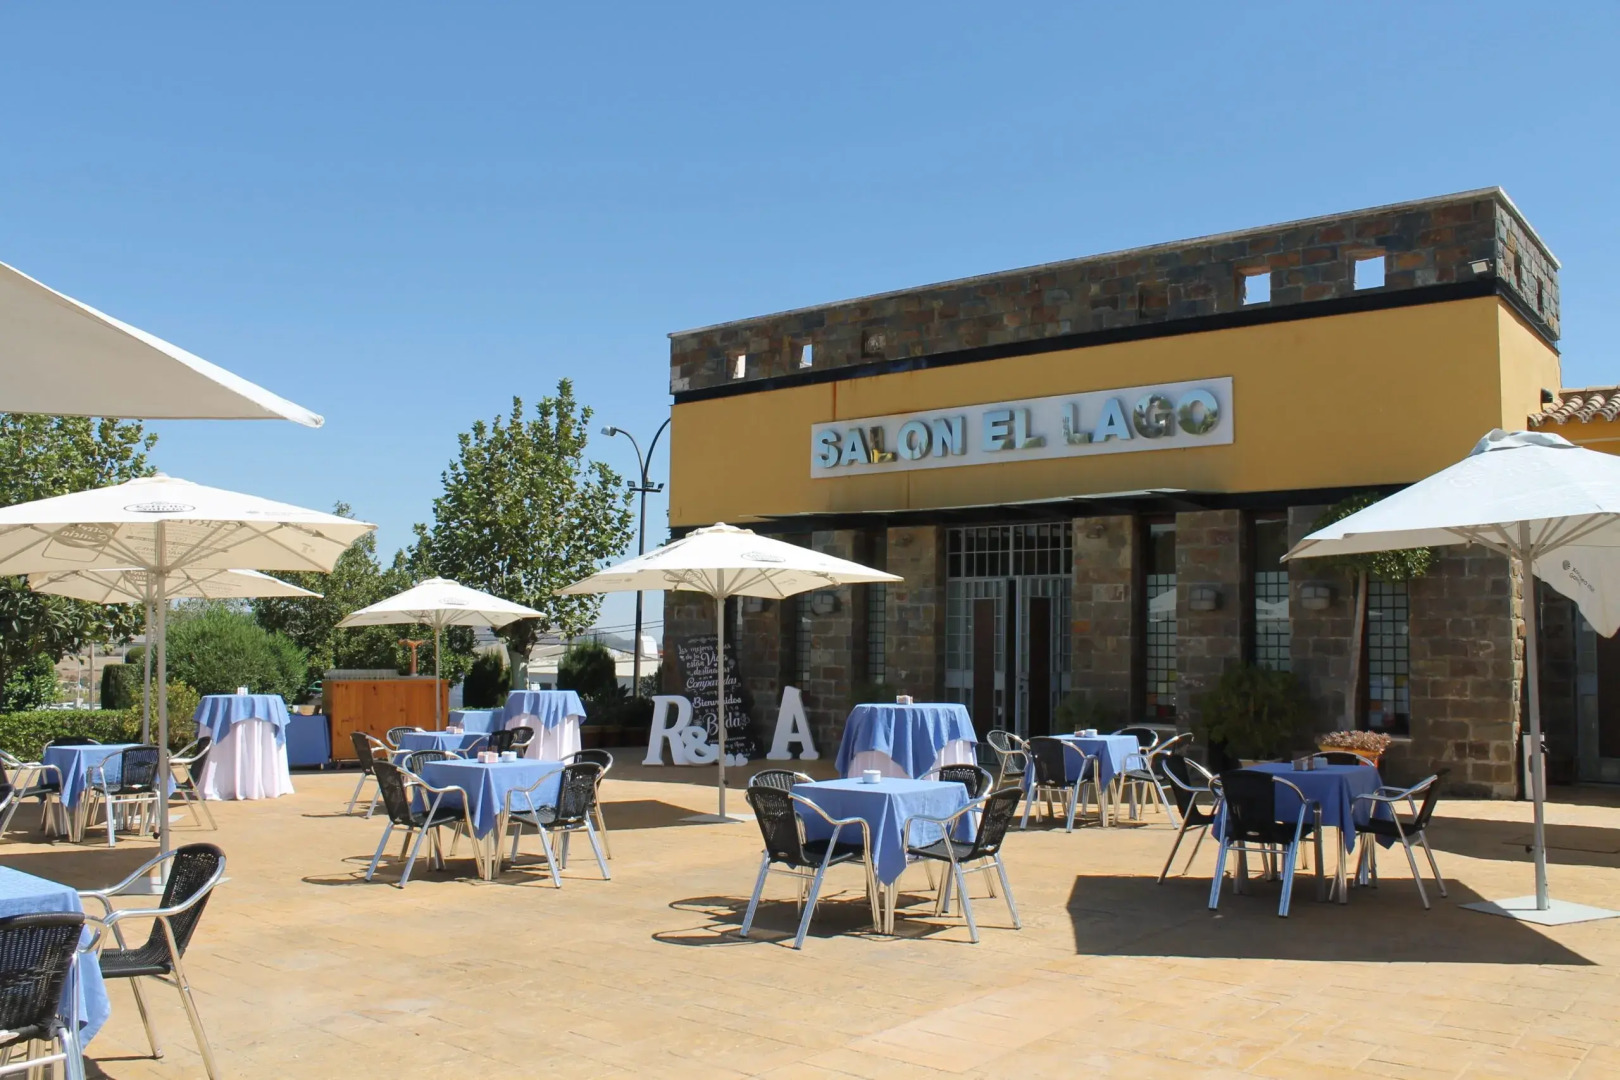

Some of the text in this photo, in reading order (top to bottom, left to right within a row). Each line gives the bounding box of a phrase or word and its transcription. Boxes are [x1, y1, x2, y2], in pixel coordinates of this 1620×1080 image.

[814, 388, 1220, 469] SALON EL LAGO
[700, 651, 729, 666] Via
[703, 712, 741, 736] Bda
[766, 685, 821, 761] A
